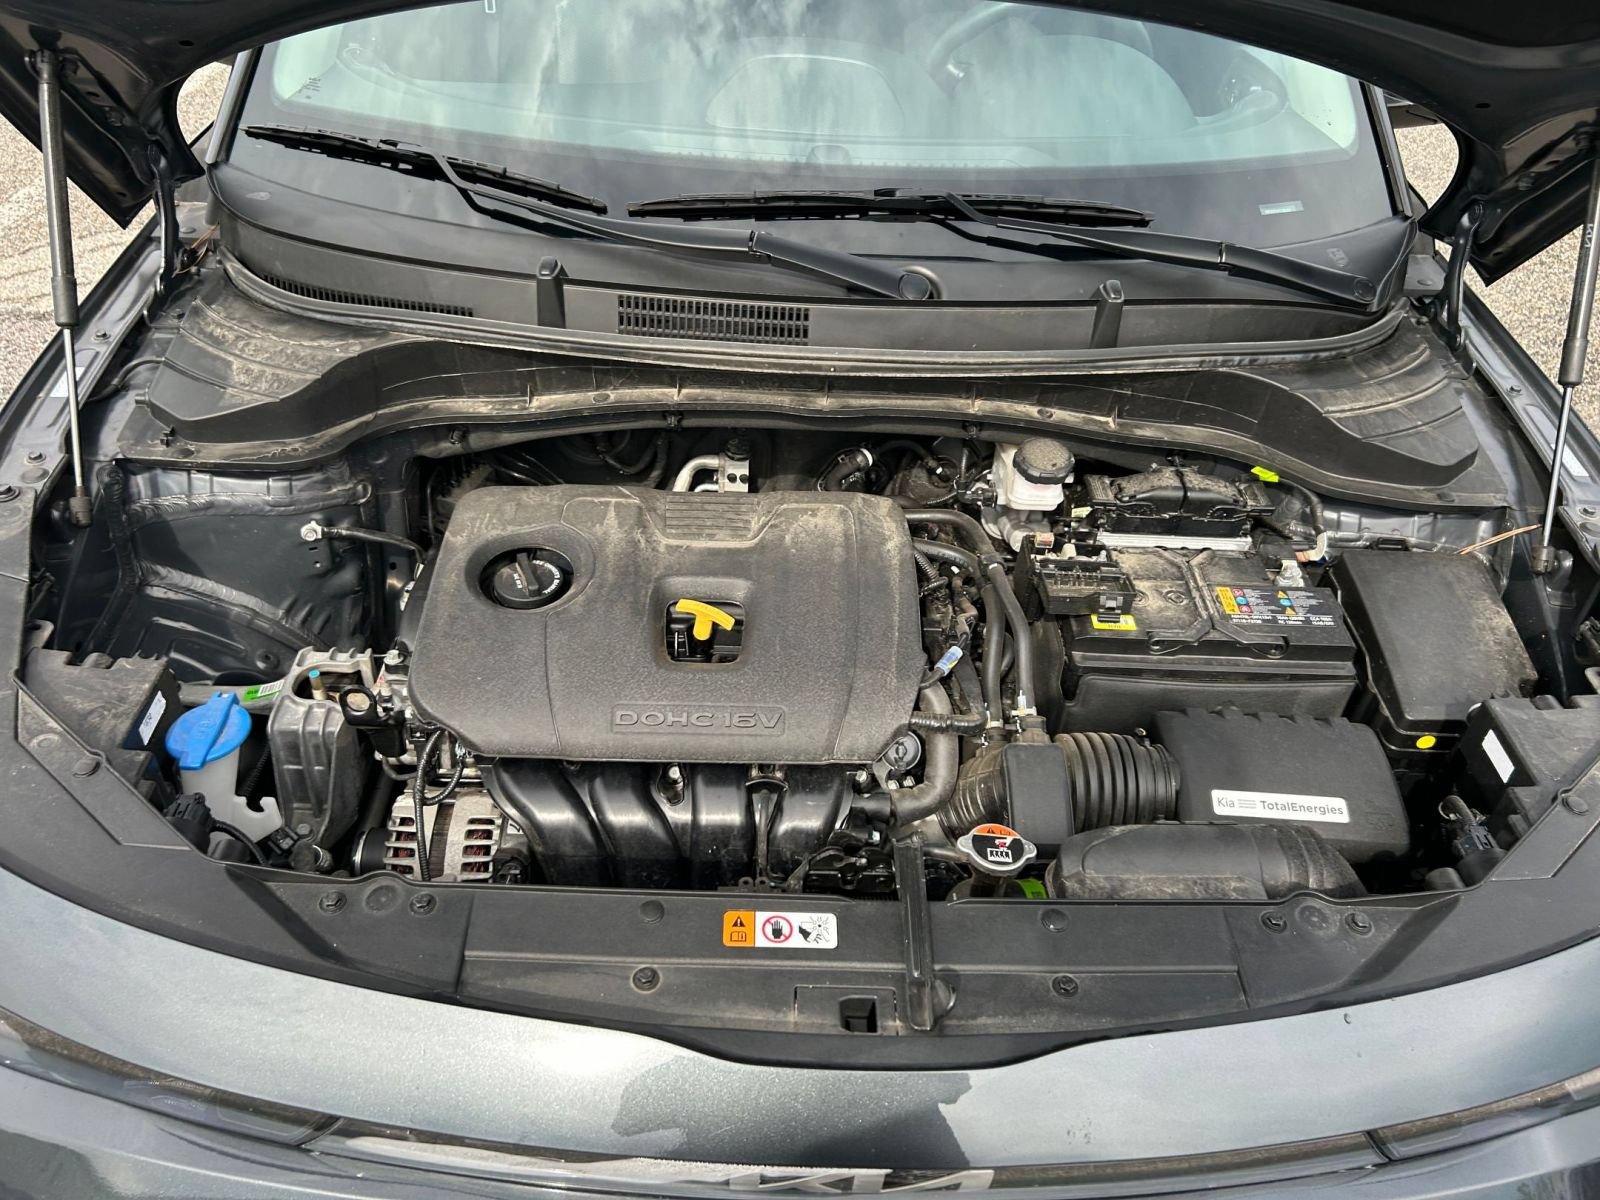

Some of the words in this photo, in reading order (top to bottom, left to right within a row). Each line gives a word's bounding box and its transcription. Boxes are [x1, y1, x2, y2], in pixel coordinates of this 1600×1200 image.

[615, 711, 714, 728] DOHC
[724, 712, 783, 729] 16V
[1217, 797, 1235, 808] Kia
[1260, 800, 1344, 815] TotalEnergies
